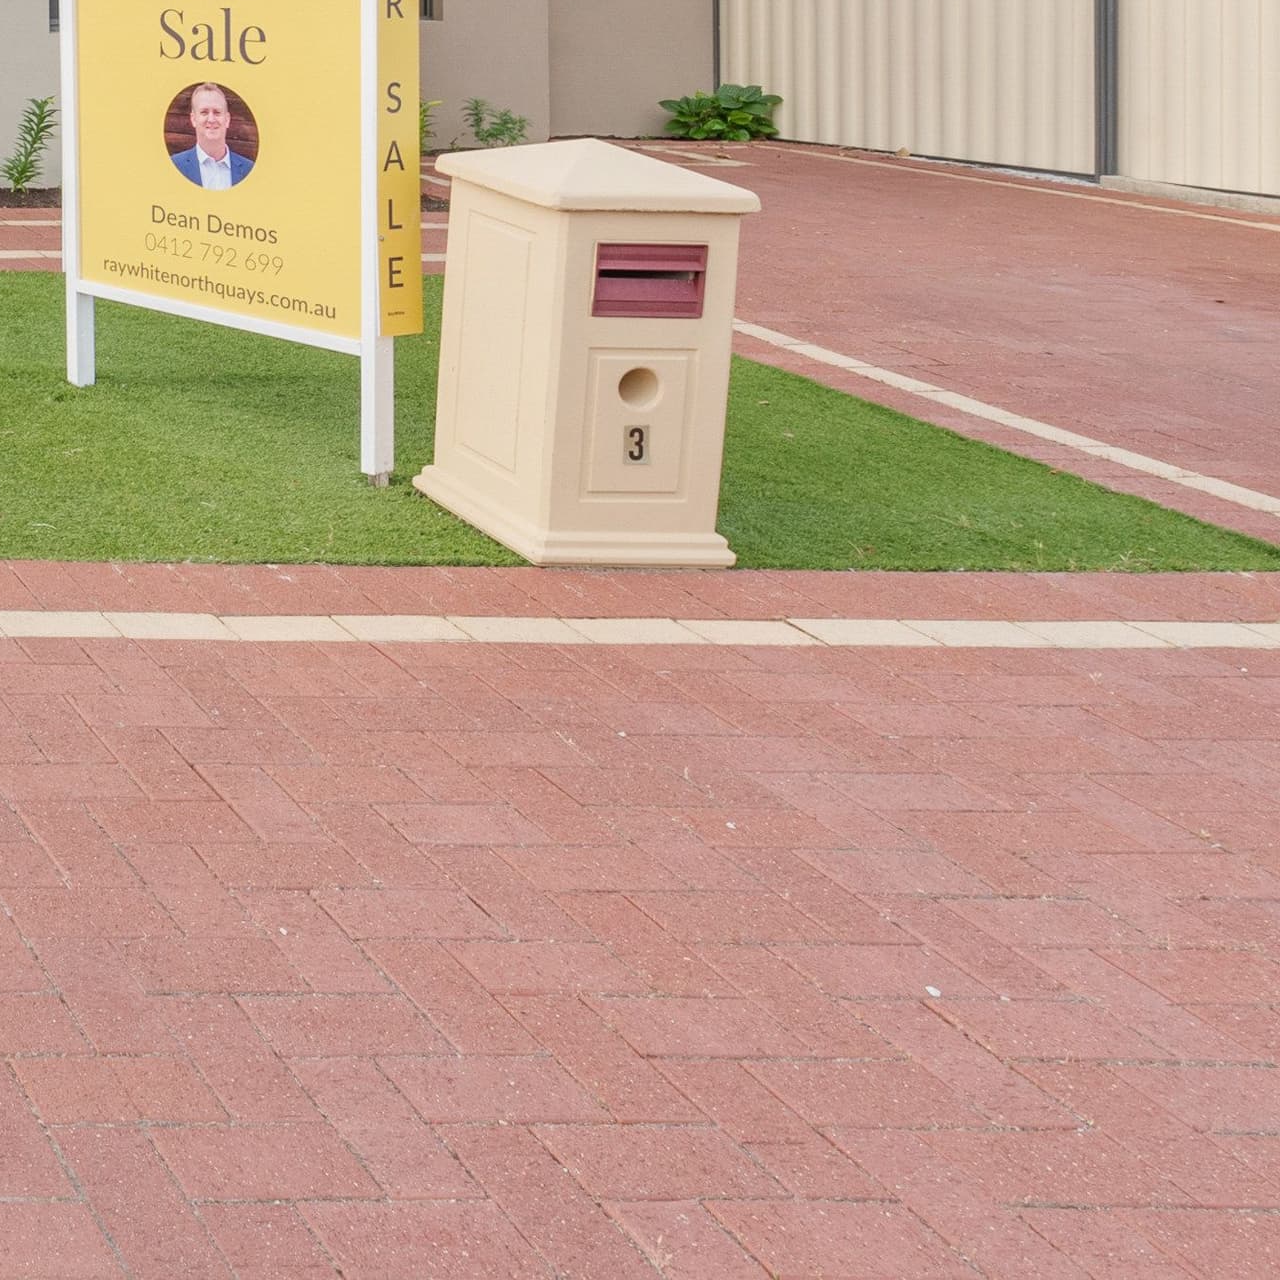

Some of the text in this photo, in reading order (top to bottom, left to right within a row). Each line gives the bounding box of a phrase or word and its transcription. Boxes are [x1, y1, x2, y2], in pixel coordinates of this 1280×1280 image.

[159, 7, 268, 65] Sale
[383, 81, 406, 289] SALE
[151, 204, 278, 244] Dean Demos
[144, 232, 284, 276] 0412 792 699
[103, 257, 337, 319] raywhitenorthquays.com.au
[628, 427, 645, 461] 3
